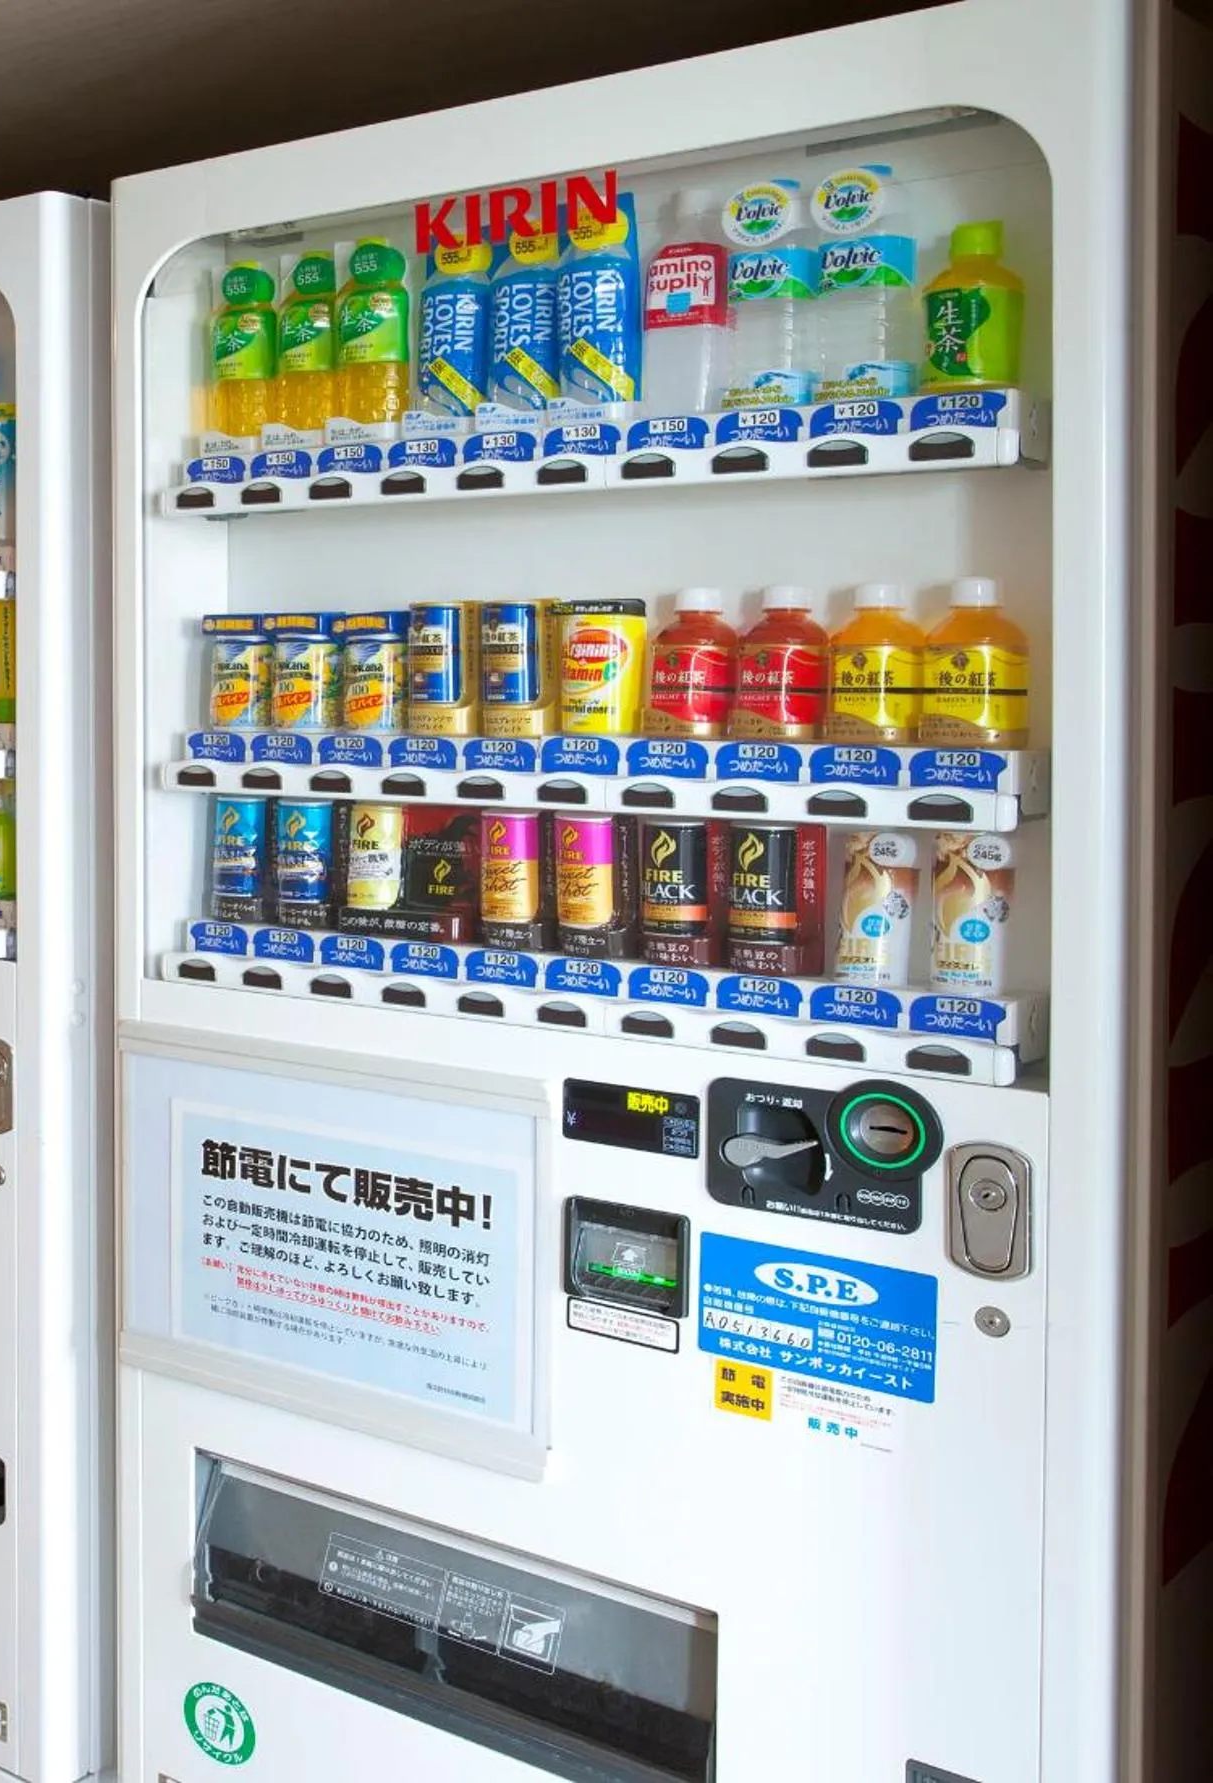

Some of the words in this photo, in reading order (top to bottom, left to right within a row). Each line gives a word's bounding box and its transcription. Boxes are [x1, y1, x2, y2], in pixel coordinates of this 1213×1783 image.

[824, 187, 874, 209] Volvic
[415, 169, 617, 255] KIRIN
[736, 202, 782, 222] Volvic
[648, 257, 712, 277] amino
[730, 257, 789, 280] Volvic
[822, 248, 883, 270] Volvic
[648, 272, 698, 293] supli
[535, 283, 555, 342] KIRIN
[572, 271, 593, 338] LOVES
[594, 270, 618, 332] KIRIN
[433, 294, 453, 356] LOVES
[454, 294, 477, 350] KIRIN
[510, 283, 534, 346] LOVES
[935, 301, 966, 353] 生茶
[841, 671, 894, 686] 後の紅茶
[936, 671, 997, 687] 後の紅茶
[351, 839, 379, 851] FIRE
[645, 868, 684, 884] FIRE
[733, 873, 771, 888] FIRE
[428, 884, 455, 896] FIRE
[627, 1091, 669, 1115] 販売中
[201, 1138, 493, 1231] 節電にて販売中!
[774, 1267, 859, 1302] S.P.E
[836, 1331, 933, 1363] 0120-06-2811
